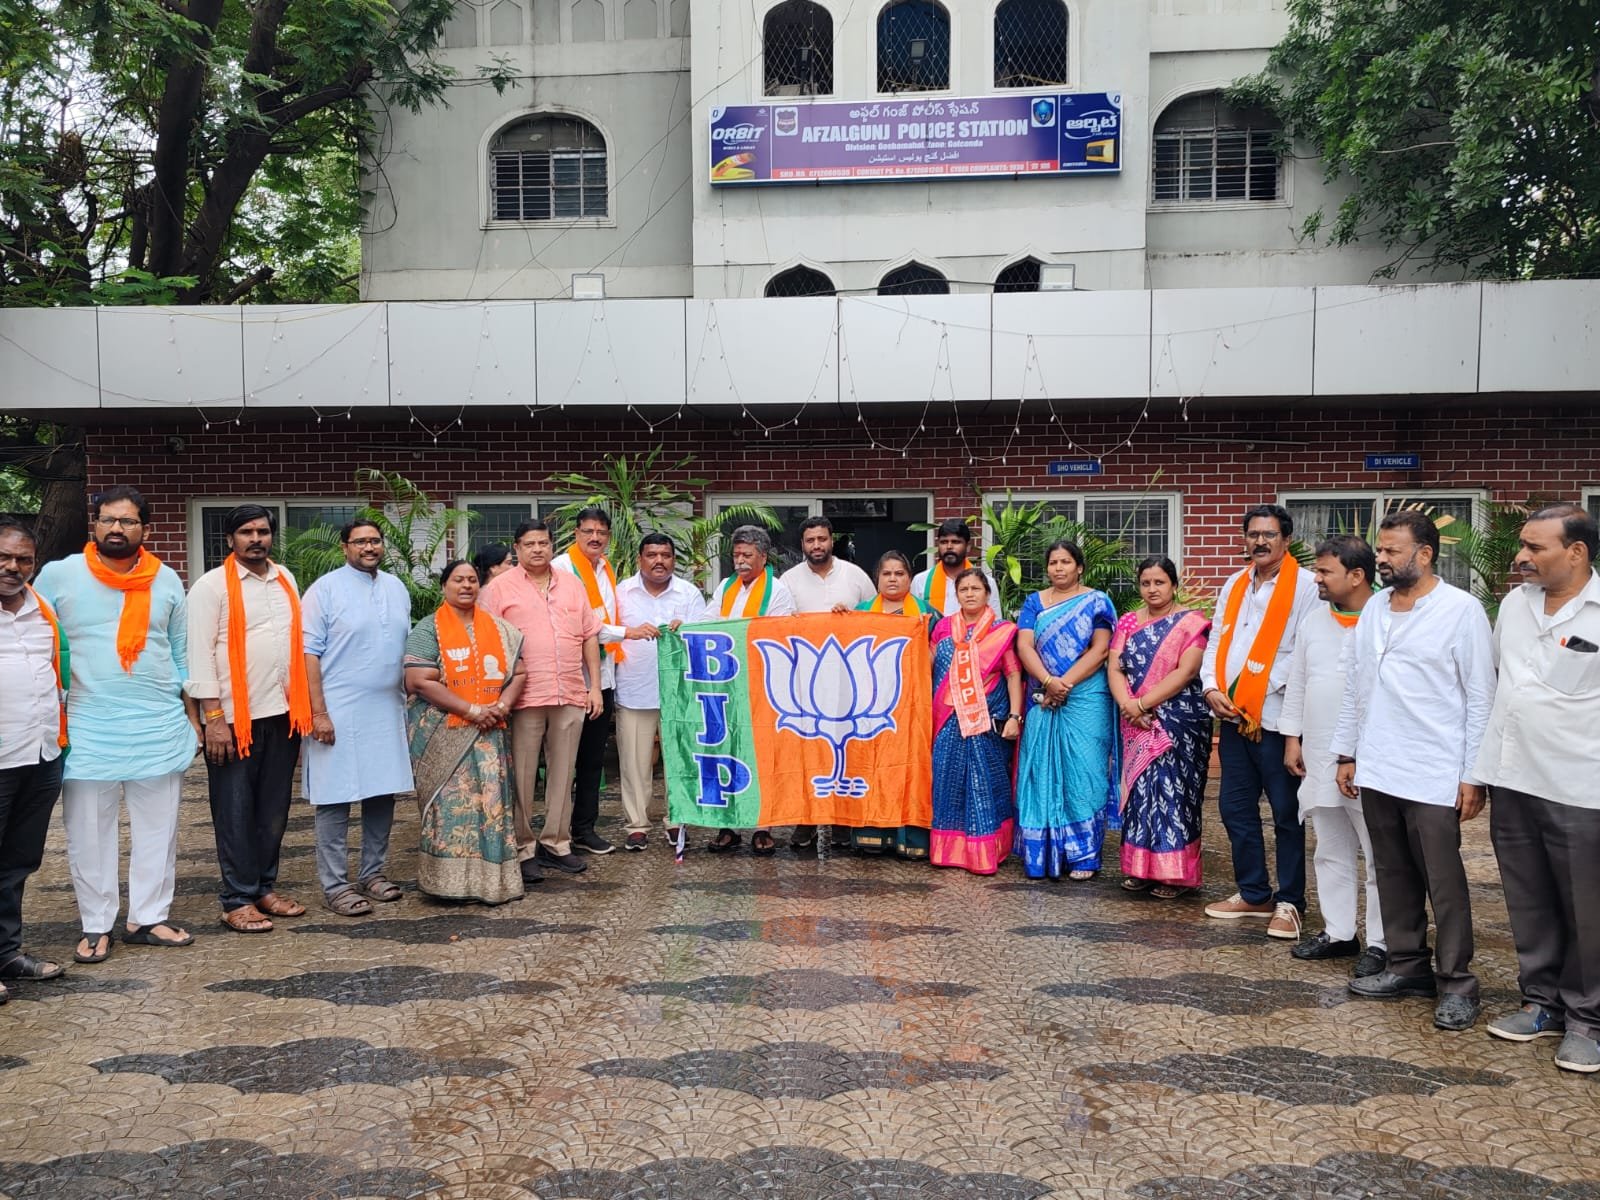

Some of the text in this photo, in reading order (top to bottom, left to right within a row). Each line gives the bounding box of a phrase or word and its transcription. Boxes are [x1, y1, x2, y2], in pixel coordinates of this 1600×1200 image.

[712, 126, 765, 141] ORBIT
[801, 118, 1029, 143] AFZALGUNJ POLICE STATION
[1383, 457, 1413, 465] VEHICLE
[1069, 463, 1093, 471] VEHICLE
